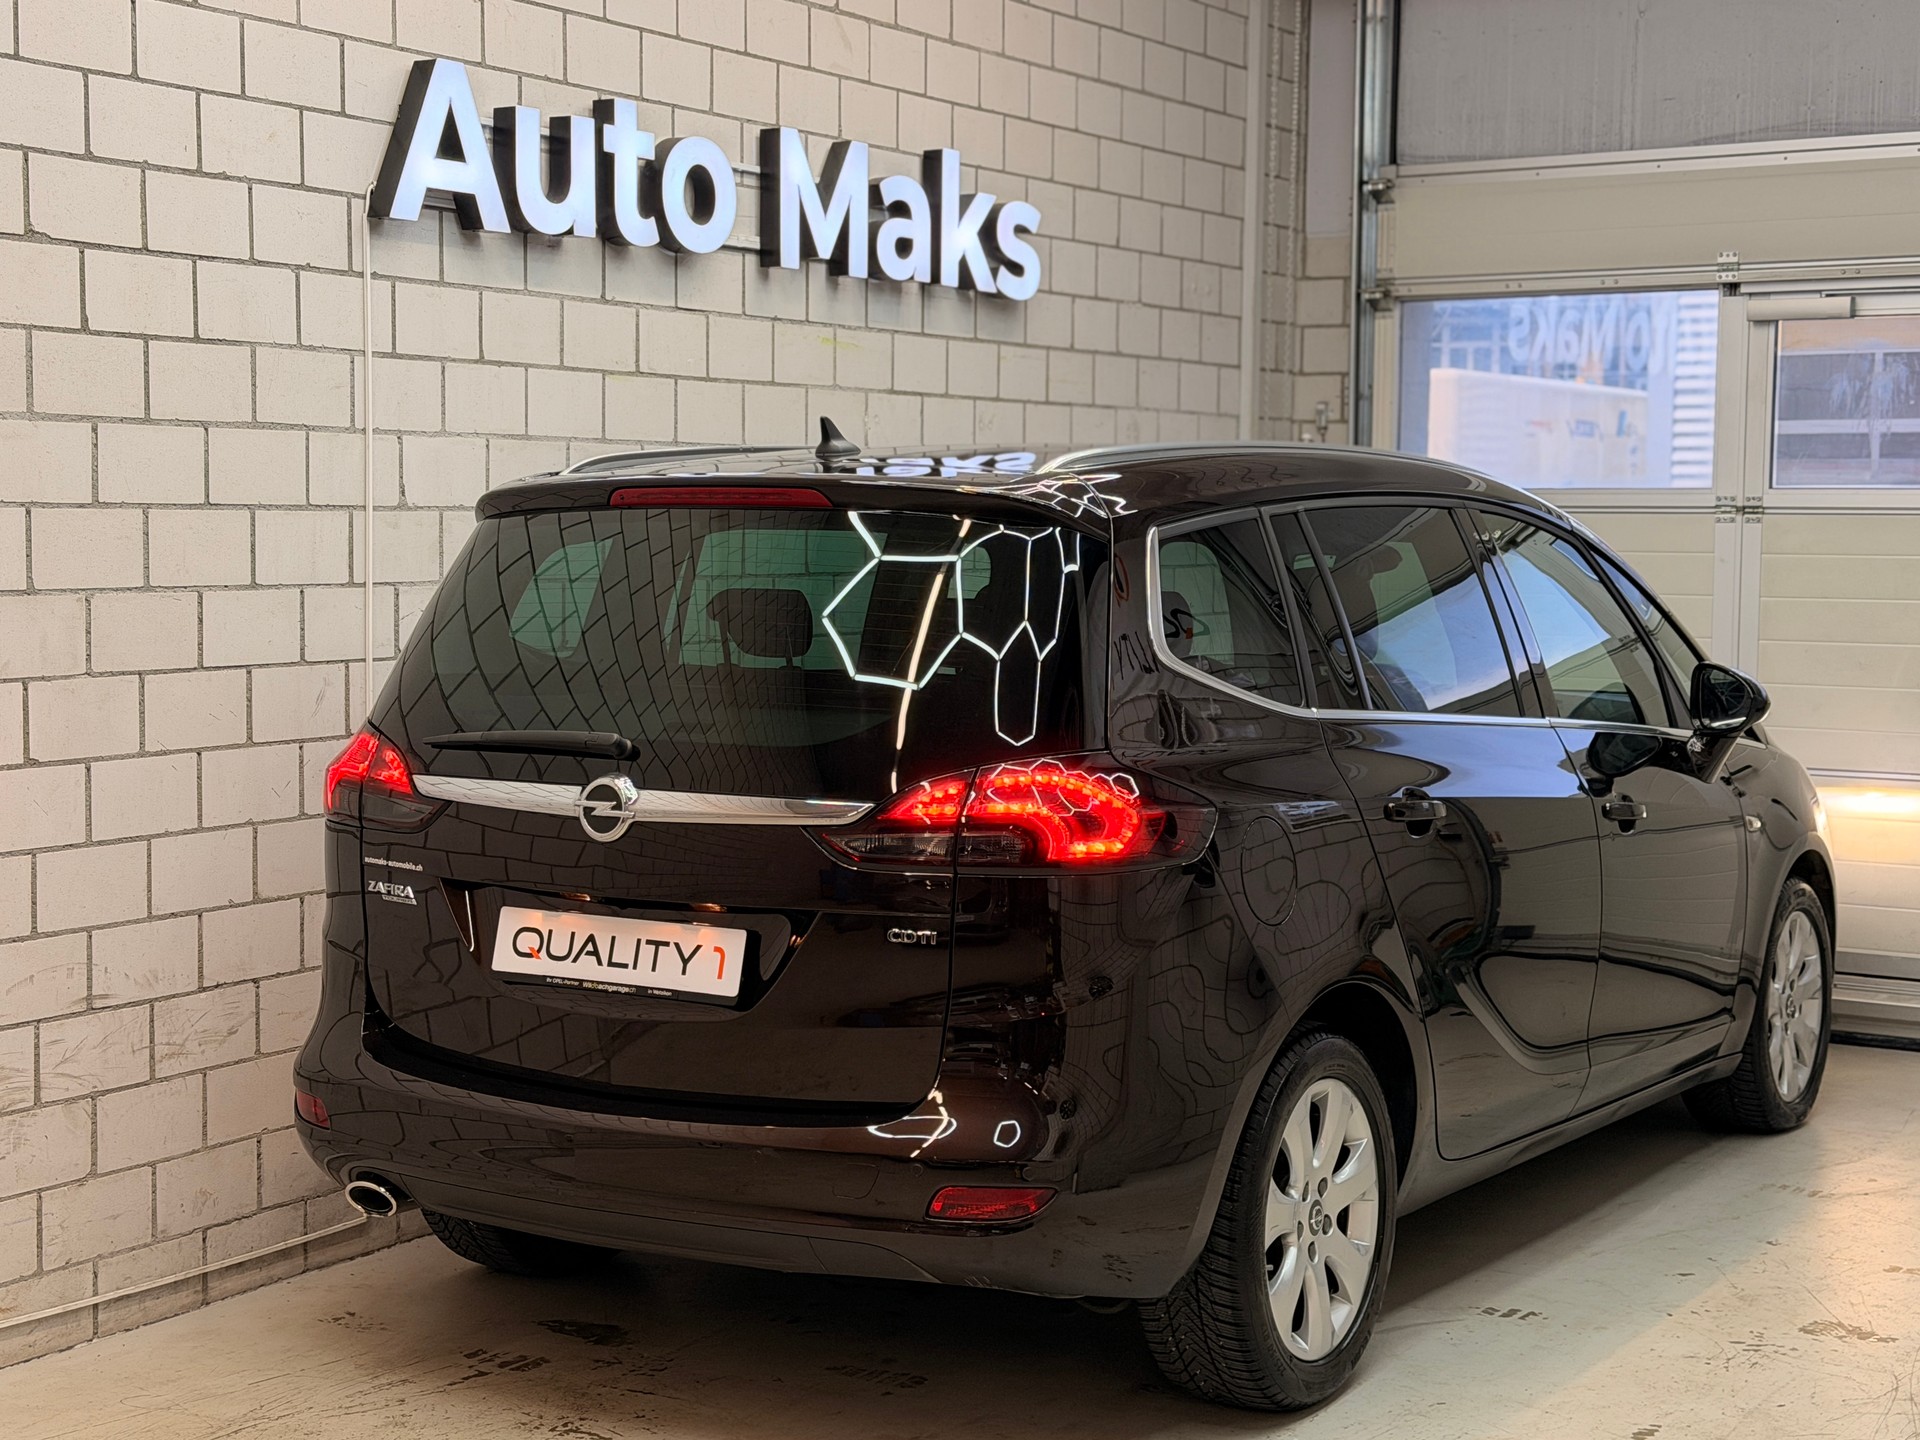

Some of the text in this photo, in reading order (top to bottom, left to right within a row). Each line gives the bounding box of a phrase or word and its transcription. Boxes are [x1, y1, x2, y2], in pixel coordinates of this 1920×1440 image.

[368, 58, 1042, 301] Auto Maks
[367, 880, 415, 899] ZAFIRA
[511, 926, 726, 980] QUALITY 1
